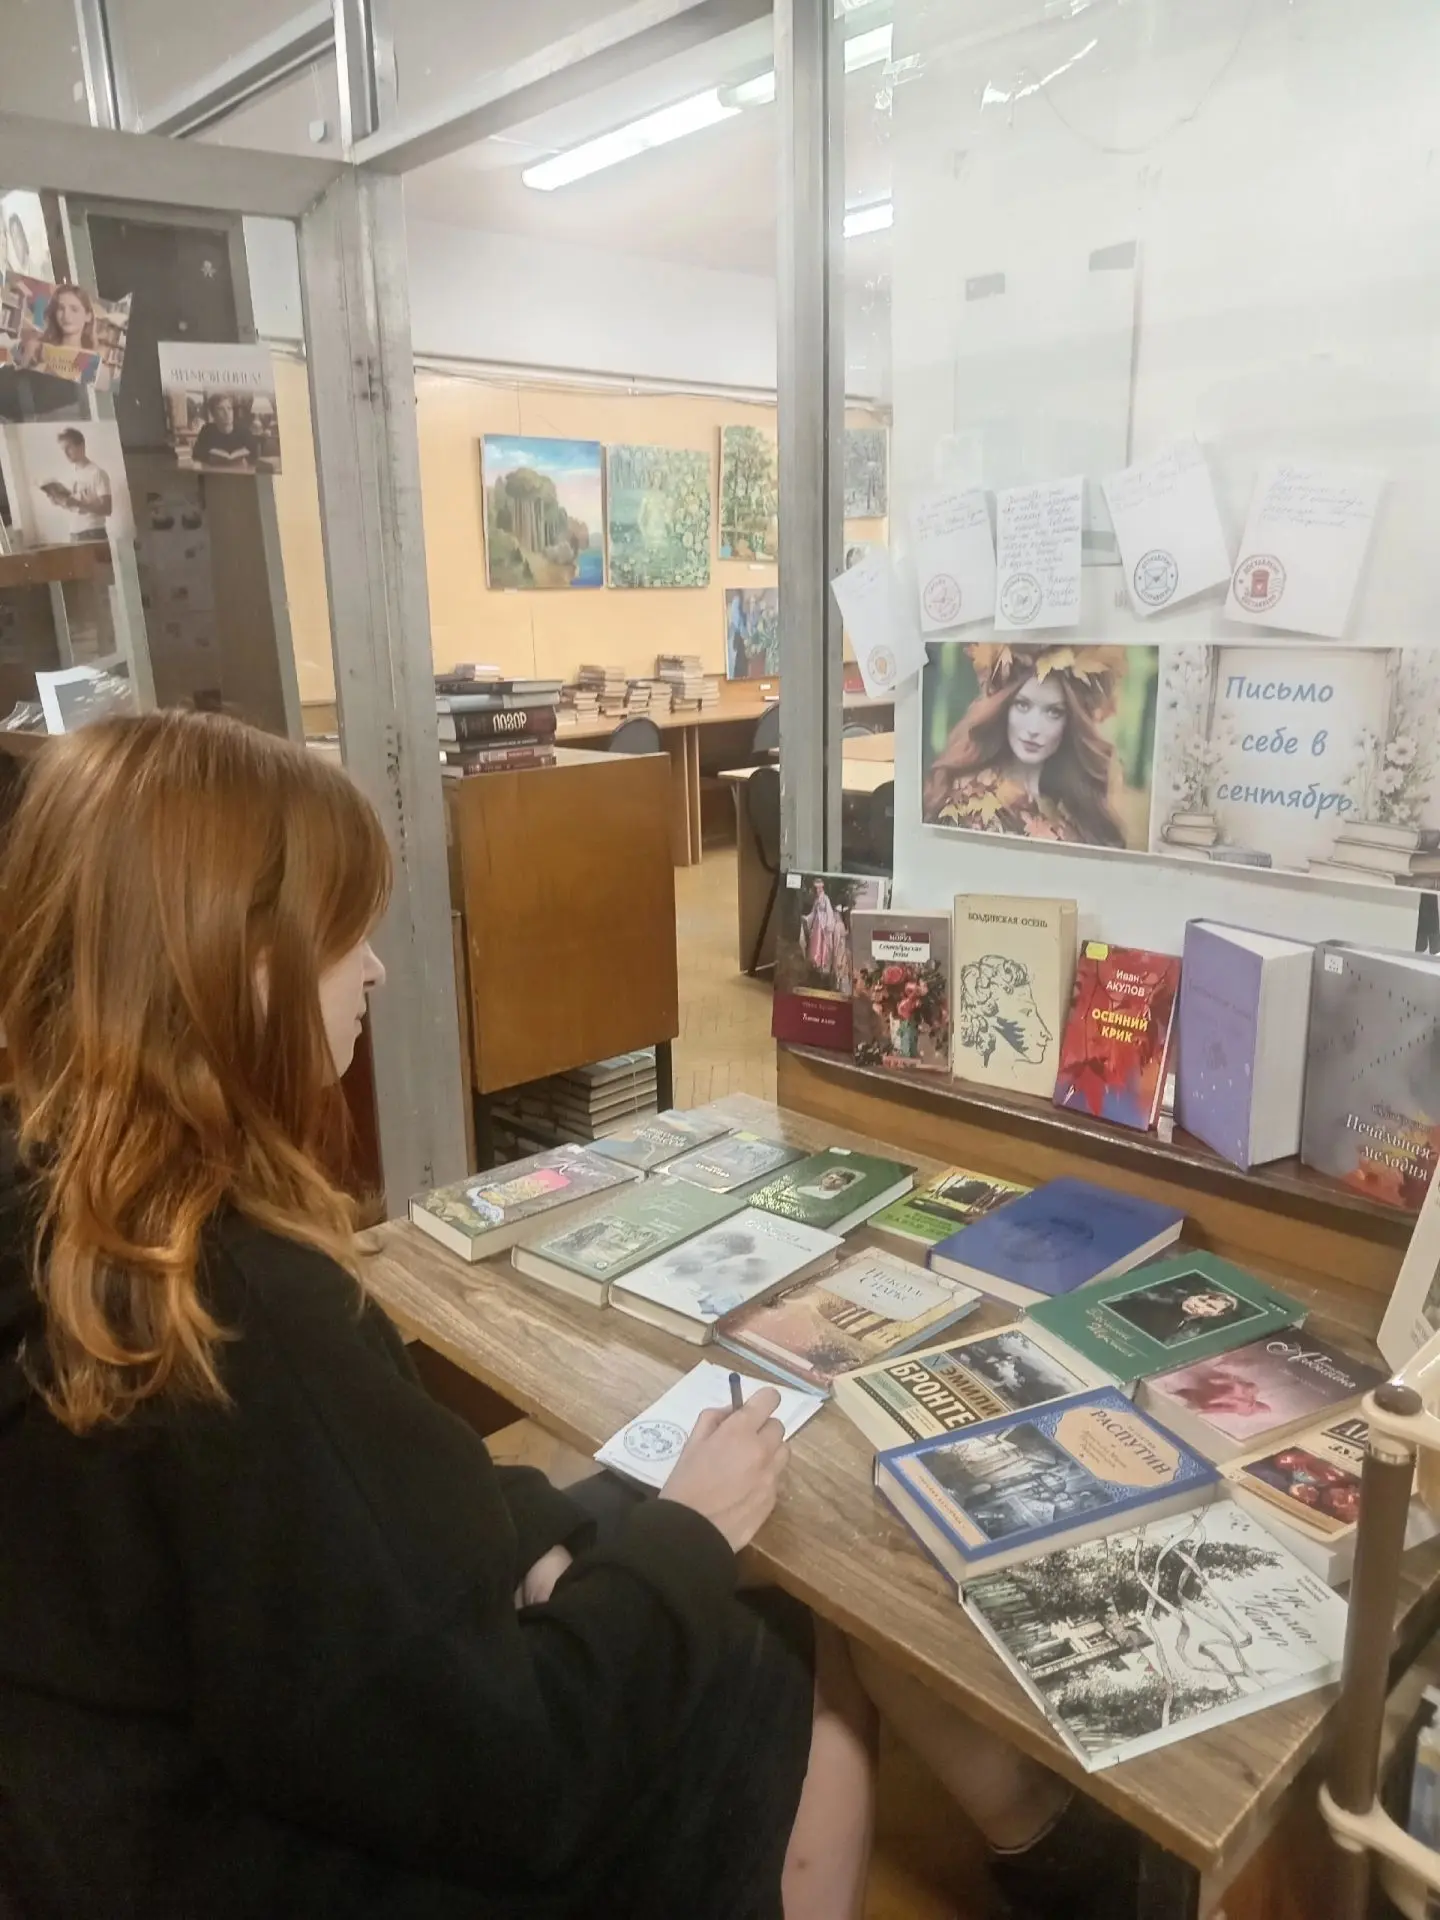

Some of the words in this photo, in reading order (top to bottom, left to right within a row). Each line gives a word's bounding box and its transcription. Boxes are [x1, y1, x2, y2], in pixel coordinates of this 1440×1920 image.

[1225, 676, 1334, 703] Письмо
[1241, 726, 1299, 755] себе
[1311, 729, 1329, 757] в
[968, 912, 1018, 926] БОЛДИНСКАЯ
[1021, 918, 1048, 929] ОСЕНЬ
[889, 933, 912, 942] МОРУА
[1105, 980, 1146, 997] АКУЛОВ
[1116, 969, 1141, 983] Иван
[1092, 1008, 1149, 1031] ОСЕННИЙ
[1101, 1025, 1133, 1042] КРИК
[1346, 1113, 1432, 1160] Печальная
[1361, 1146, 1429, 1181] мелодия
[889, 1362, 976, 1430] БРОНТЕ
[940, 1366, 1000, 1417] ЭМИЛИ
[1090, 1410, 1172, 1475] РАСПУТИН
